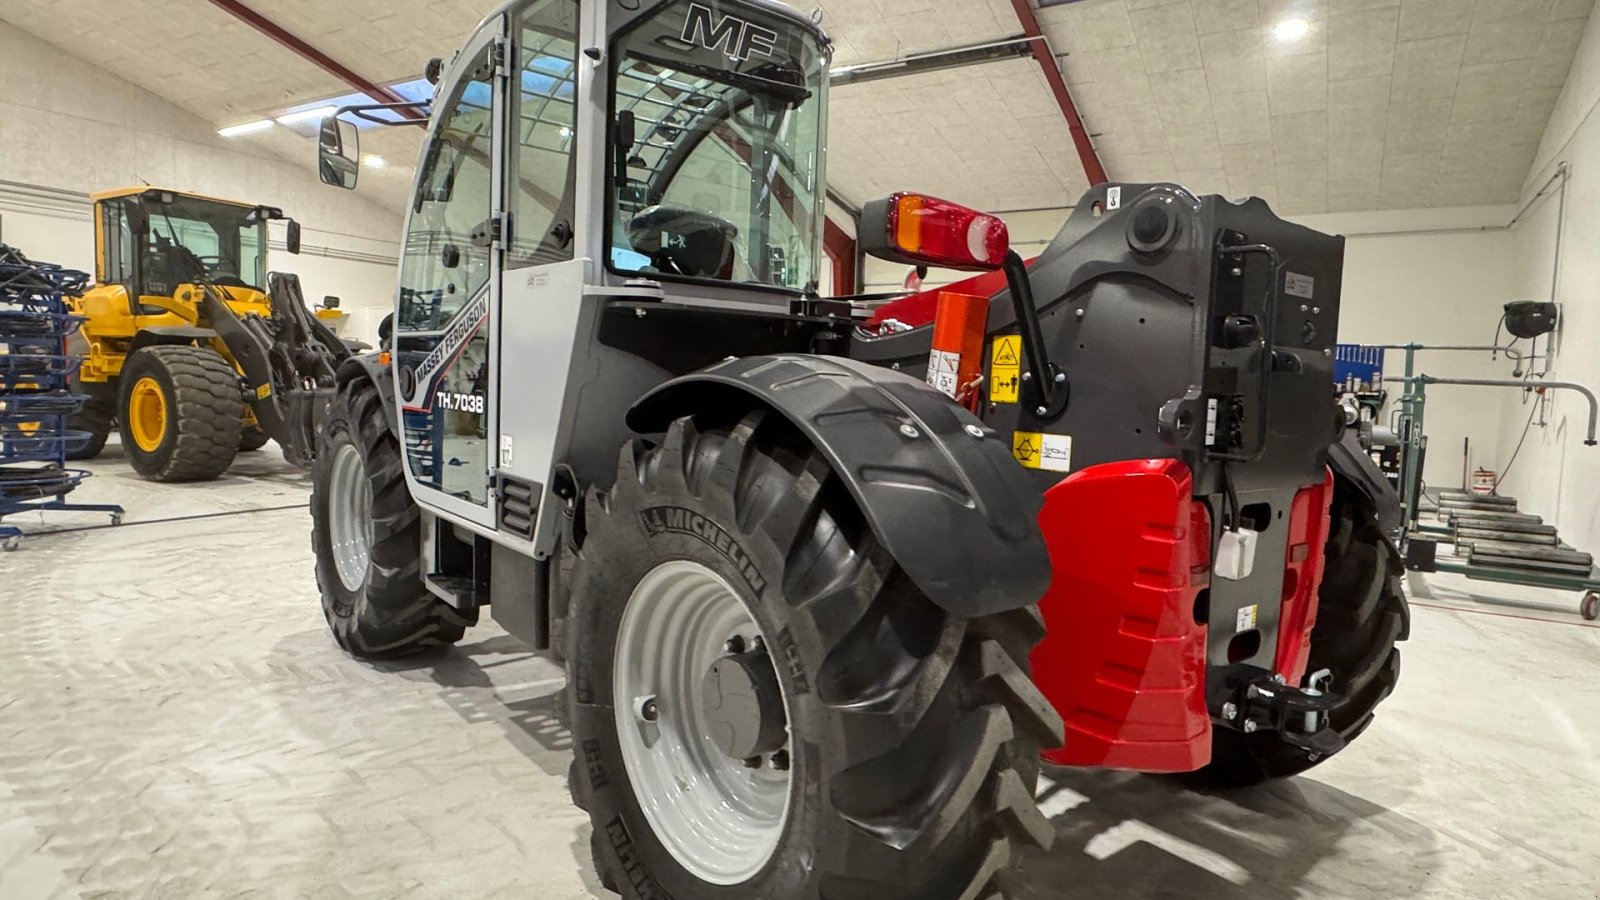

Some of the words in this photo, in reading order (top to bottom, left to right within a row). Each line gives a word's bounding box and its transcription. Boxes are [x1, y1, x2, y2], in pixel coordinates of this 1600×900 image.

[681, 3, 777, 61] MF
[416, 344, 444, 385] MASSEY
[444, 297, 486, 354] FERGUSON
[437, 392, 484, 413] TH.7038
[665, 507, 766, 592] MICHELIN
